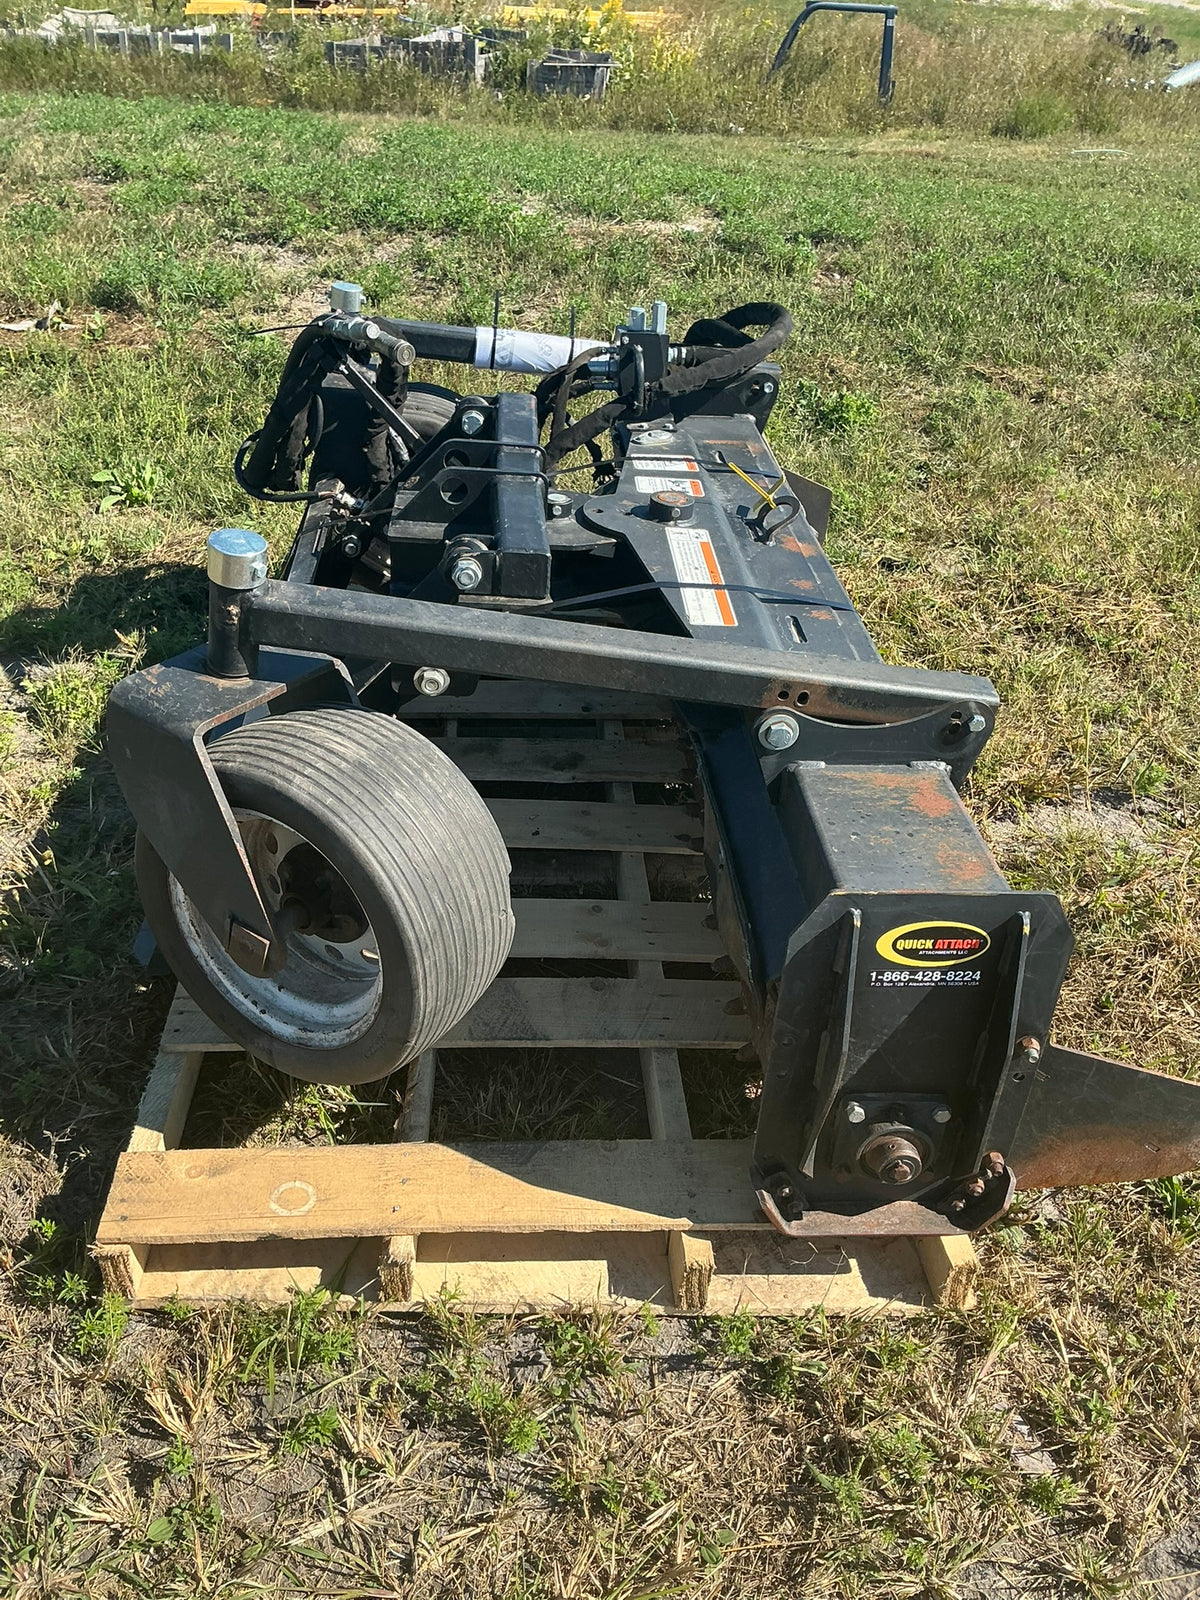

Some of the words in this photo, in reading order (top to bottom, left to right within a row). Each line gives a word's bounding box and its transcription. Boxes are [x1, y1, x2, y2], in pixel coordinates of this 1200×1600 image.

[896, 939, 934, 951] QUICK
[934, 939, 980, 949] ATTACH
[870, 971, 981, 982] 1-866-428-8224
